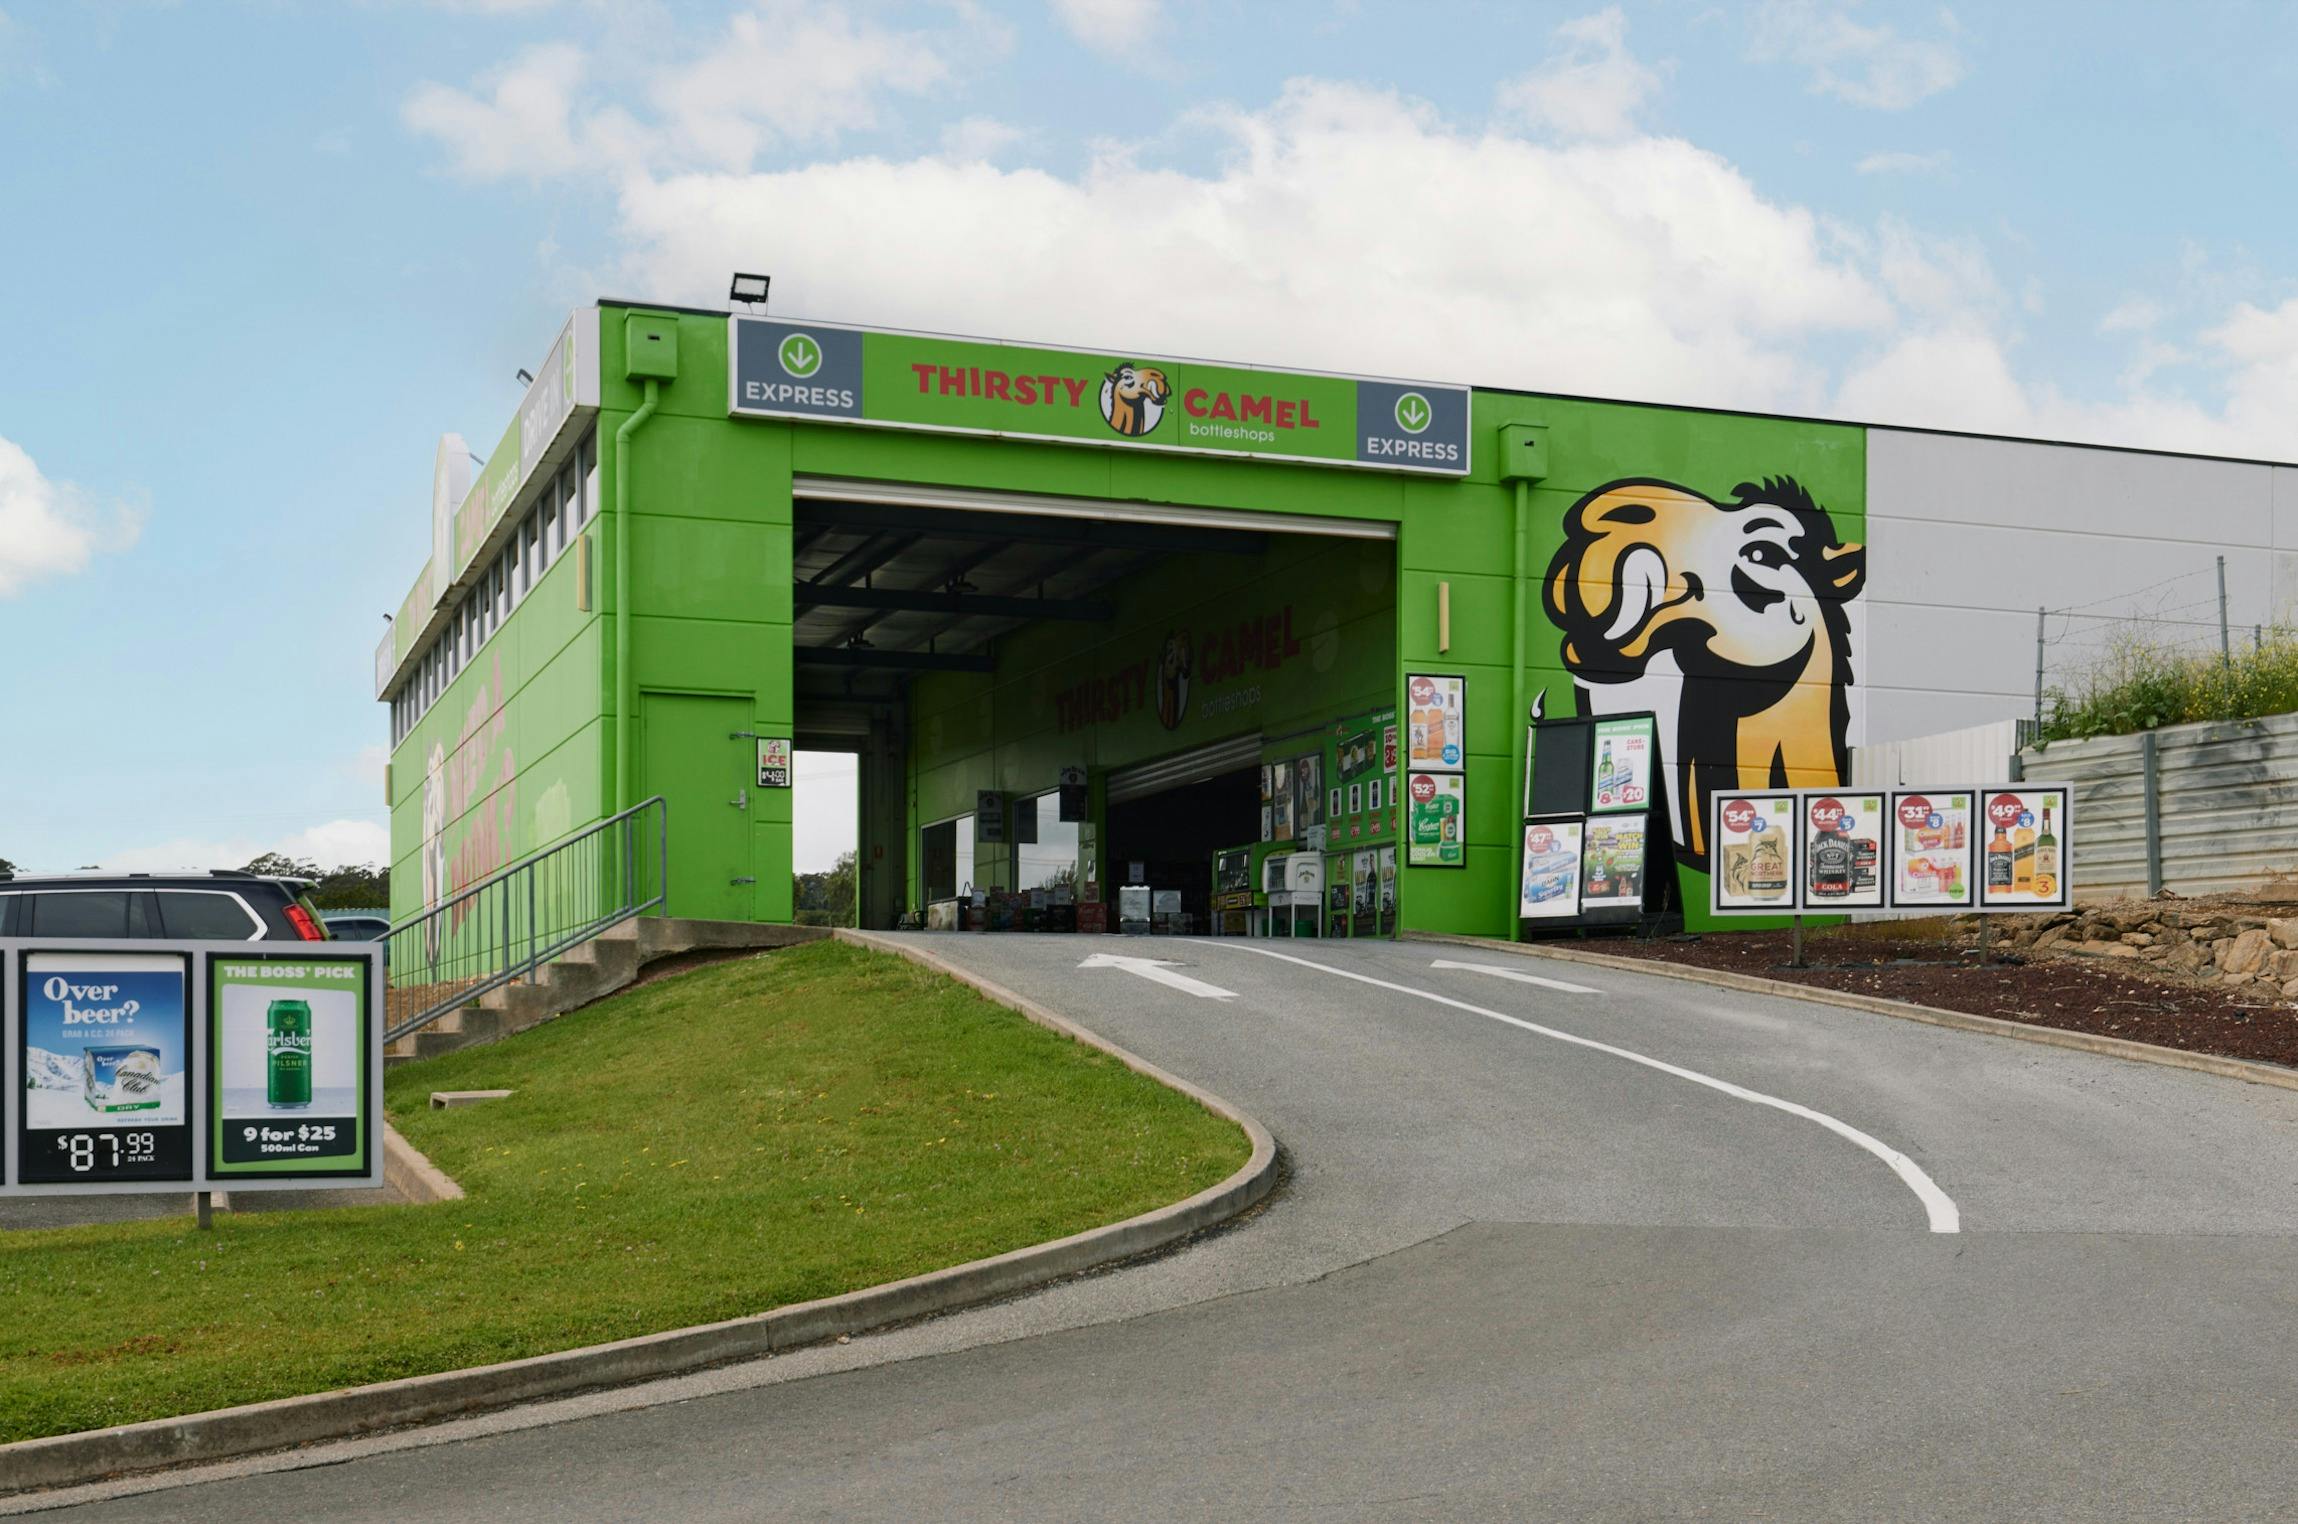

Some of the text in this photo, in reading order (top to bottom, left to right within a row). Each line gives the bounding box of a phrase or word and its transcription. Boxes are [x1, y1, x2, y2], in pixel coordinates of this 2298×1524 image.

[746, 381, 855, 410] EXPRESS
[912, 364, 1319, 429] THIRSTY CAMEL
[1189, 422, 1275, 444] bottleshops
[1367, 435, 1458, 463] EXPRESS
[1199, 604, 1300, 686] CAMEL
[1201, 686, 1263, 721] bottleshops
[763, 754, 785, 766] ICE
[1750, 862, 1783, 871] GREAT
[1822, 882, 1843, 891] COLA
[2038, 881, 2051, 894] 3
[224, 966, 354, 979] THE BOSS' PICK
[44, 977, 118, 1001] Over
[62, 1000, 140, 1024] beer?
[271, 1059, 309, 1067] PILSNER
[115, 1065, 160, 1085] Canadian
[123, 1077, 149, 1093] Club
[117, 1103, 140, 1111] DRY
[243, 1124, 336, 1142] 9 for $25
[261, 1143, 320, 1153] 500ml Can
[137, 1154, 156, 1163] PACK
